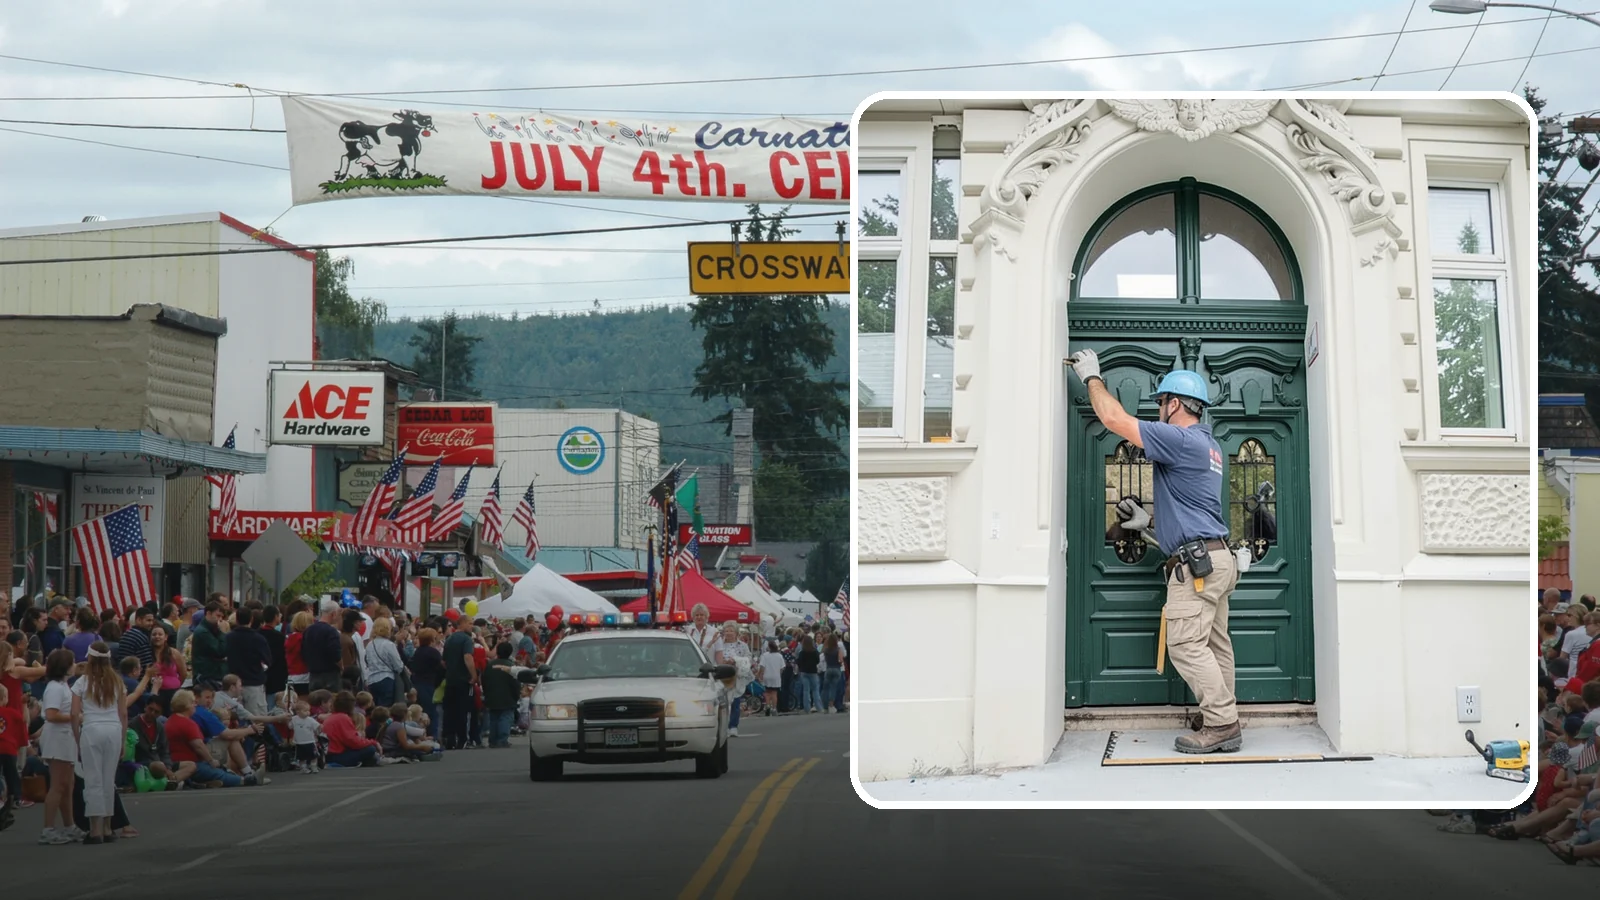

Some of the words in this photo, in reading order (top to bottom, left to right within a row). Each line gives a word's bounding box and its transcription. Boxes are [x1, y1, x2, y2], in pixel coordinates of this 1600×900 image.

[481, 141, 605, 192] JULY
[632, 149, 746, 198] 4th.
[696, 254, 850, 280] CROSSWA
[283, 380, 374, 420] ACE
[405, 409, 453, 422] CEDAR
[461, 409, 485, 421] LOG
[284, 421, 371, 437] Hardware
[416, 428, 477, 447] Coca-Cola
[96, 485, 124, 495] Vincent
[126, 485, 136, 495] de
[137, 485, 155, 495] Paul
[688, 526, 742, 535] CRNATION
[699, 535, 731, 543] GLASS
